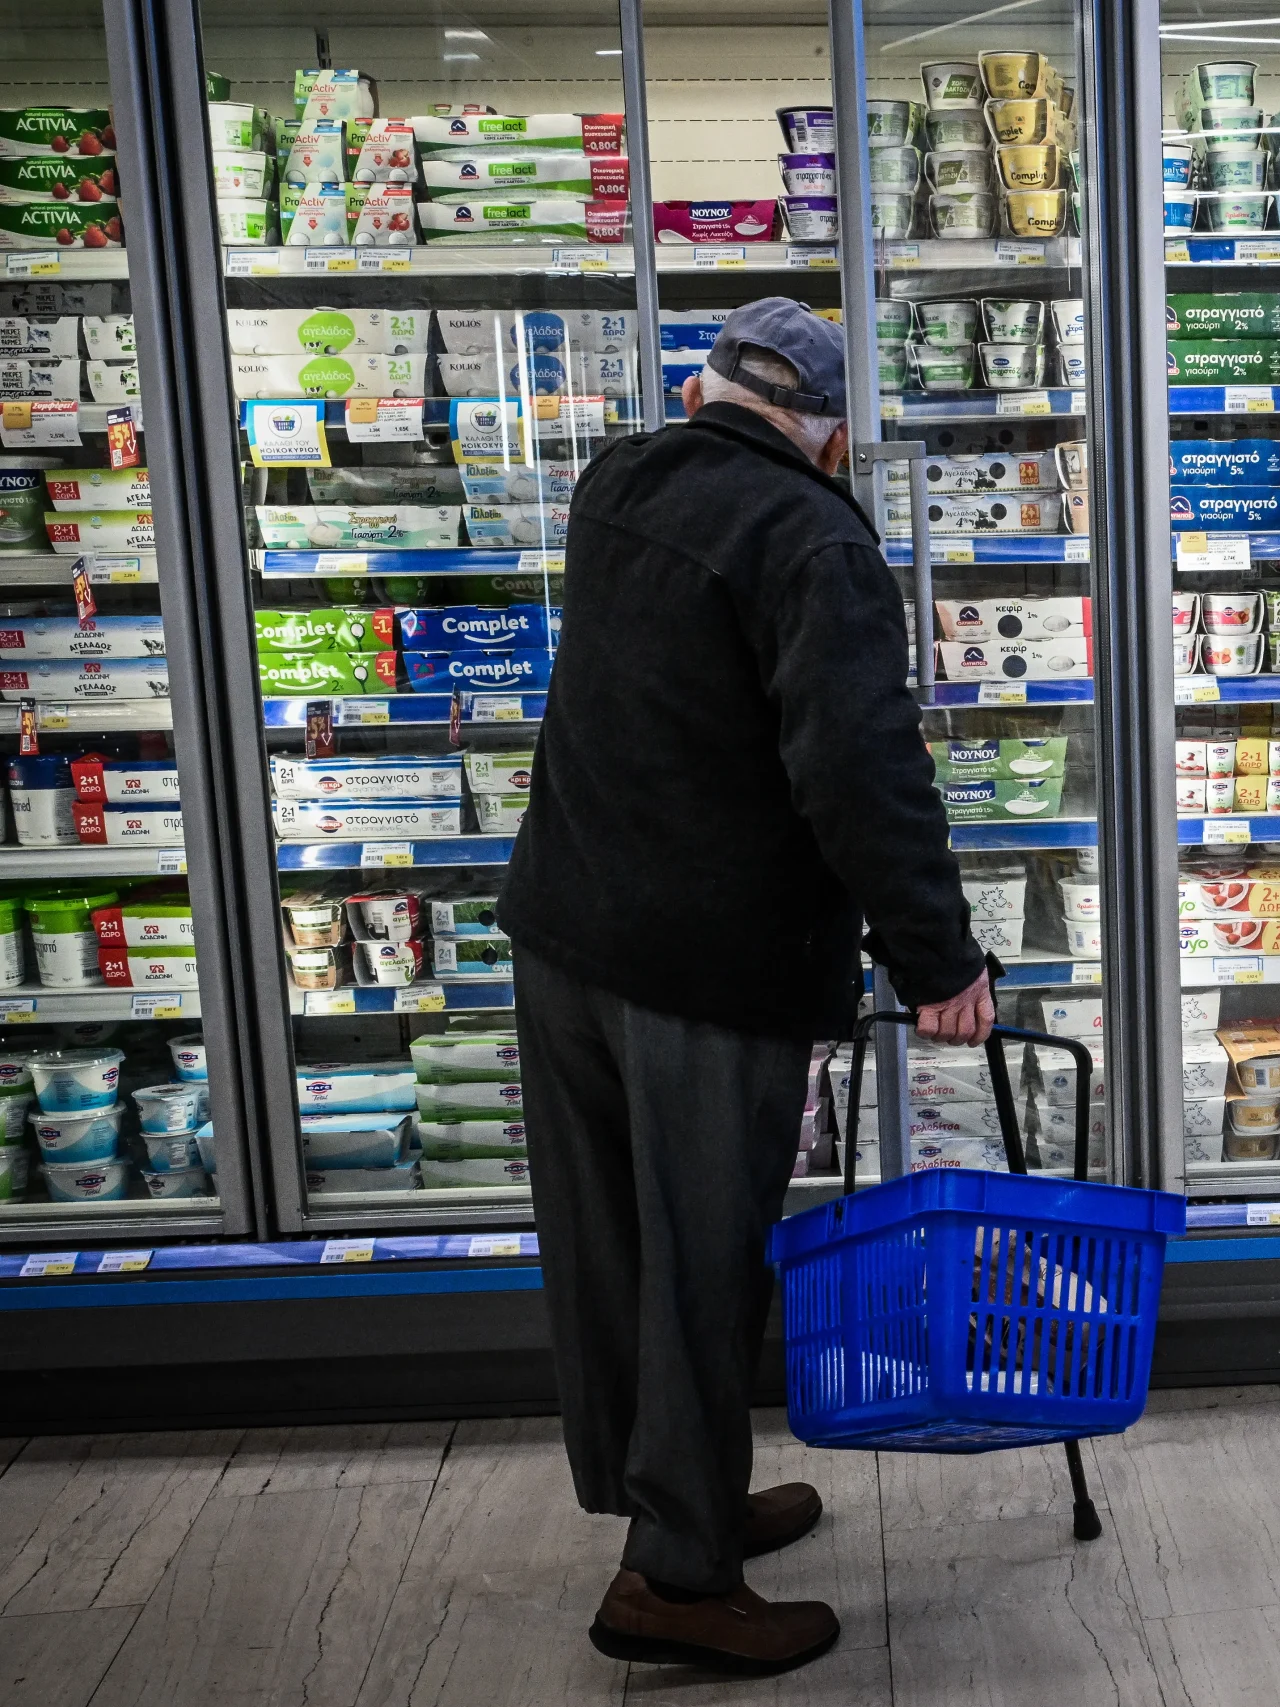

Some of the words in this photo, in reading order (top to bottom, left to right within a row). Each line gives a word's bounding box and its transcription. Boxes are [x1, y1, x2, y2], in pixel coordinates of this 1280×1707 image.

[16, 118, 77, 131] ACTIVIA
[482, 121, 522, 132] freelact
[586, 142, 617, 151] -0,80€
[18, 165, 76, 179] ACTIVIA
[493, 165, 533, 175] freelact
[595, 185, 625, 194] -0,80€
[21, 212, 81, 224] ACTIVIA
[487, 208, 526, 218] freelact
[692, 208, 729, 217] ΝΟΥΝΟΥ
[589, 228, 620, 237] -0,80€
[1186, 305, 1264, 321] στραγγιστό
[390, 317, 415, 329] 2+1
[602, 317, 625, 329] 2+1
[1186, 321, 1220, 331] γιαούρτι
[1235, 320, 1248, 330] 2%
[303, 326, 352, 337] αγελάδος
[1185, 351, 1263, 367] στραγγιστό
[388, 361, 411, 373] 2+1
[600, 359, 623, 371] 2+1
[304, 372, 351, 381] αγελάδος
[1185, 367, 1219, 377] γιαούρτι
[1233, 366, 1246, 376] 2%
[1182, 451, 1260, 467] στραγγιστό
[1182, 467, 1216, 476] γιαούρτι
[1230, 465, 1244, 475] 5%
[1200, 496, 1278, 512] στραγγιστό
[1200, 512, 1234, 521] γιαούρτι
[1248, 511, 1262, 521] 5%
[995, 604, 1023, 613] κεφίρ
[442, 614, 529, 636] Complet
[255, 622, 336, 640] Complet
[69, 642, 112, 651] ΑΓΕΛΑΔΟΣ
[1000, 645, 1027, 653] κεφίρ
[260, 662, 338, 684] Complet
[449, 659, 532, 680] Complet
[74, 684, 117, 693] ΑΓΕΛΑΔΟΣ
[951, 750, 996, 760] ΝΟΥΝΟΥ
[952, 767, 987, 775] Στραγγιστό
[346, 774, 420, 786] στραγγιστό
[947, 790, 992, 800] ΝΟΥΝΟΥ
[948, 807, 983, 815] Στραγγιστό
[346, 814, 419, 826] στραγγιστό
